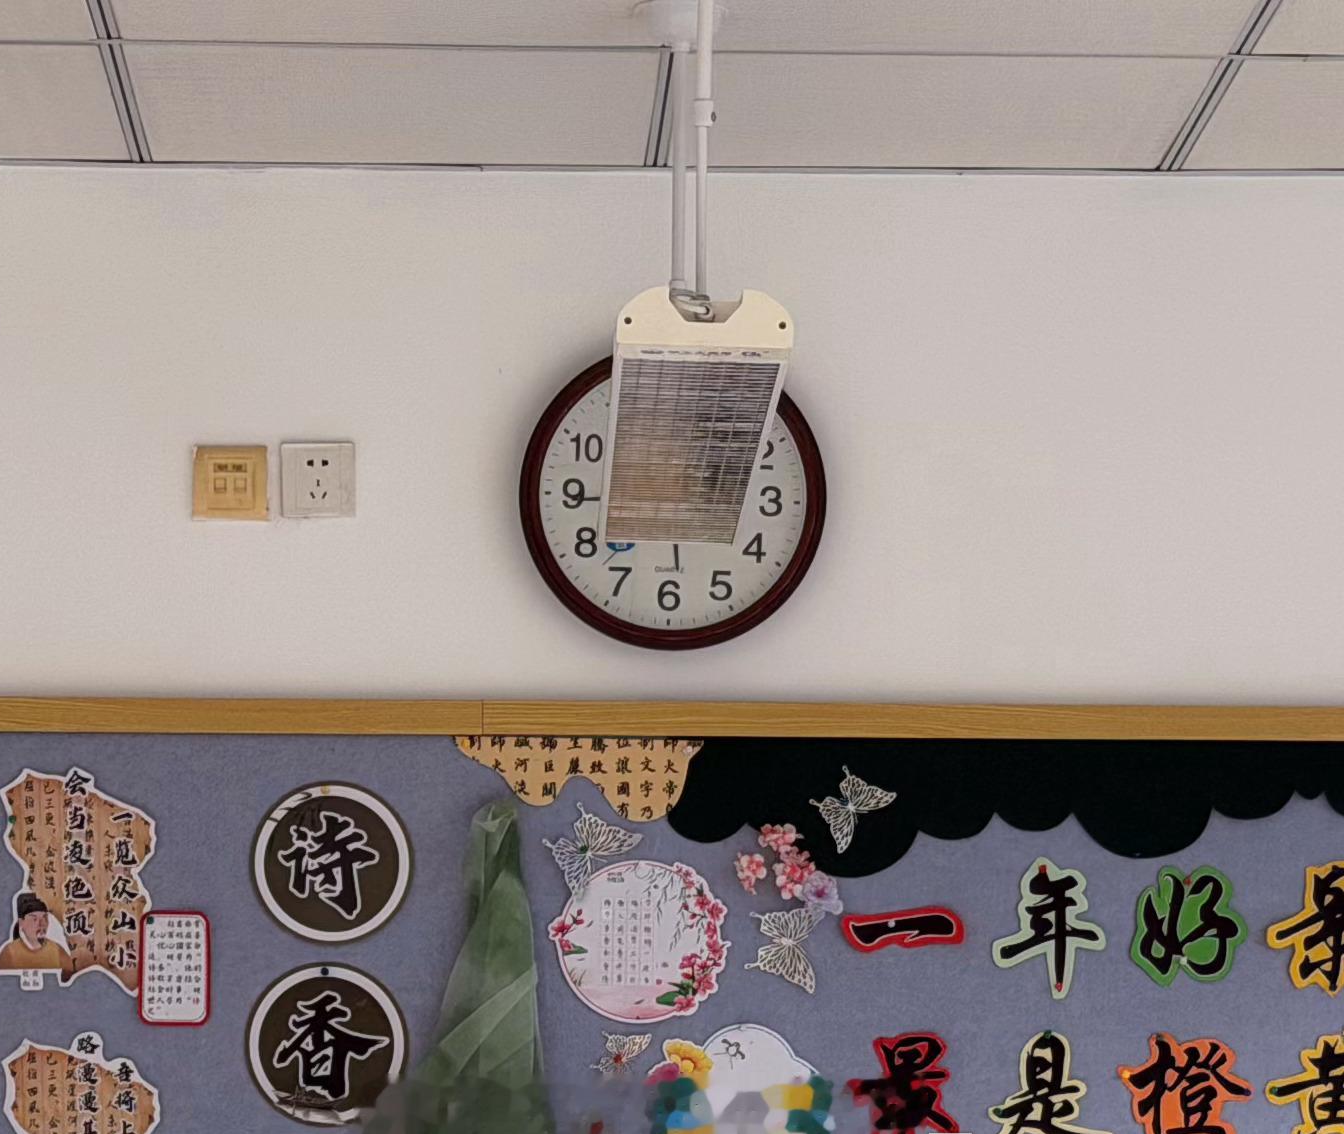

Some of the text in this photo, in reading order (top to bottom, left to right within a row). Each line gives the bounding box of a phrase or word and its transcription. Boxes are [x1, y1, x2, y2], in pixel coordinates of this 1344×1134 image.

[570, 434, 603, 463] 10
[563, 478, 586, 509] 9
[759, 486, 782, 516] 3
[575, 527, 598, 558] 8
[742, 533, 766, 563] 4
[608, 567, 632, 596] 7
[658, 580, 680, 611] 6
[709, 571, 732, 601] 5
[64, 771, 93, 935] 会当凌绝顶
[111, 813, 138, 968] 一览众山小
